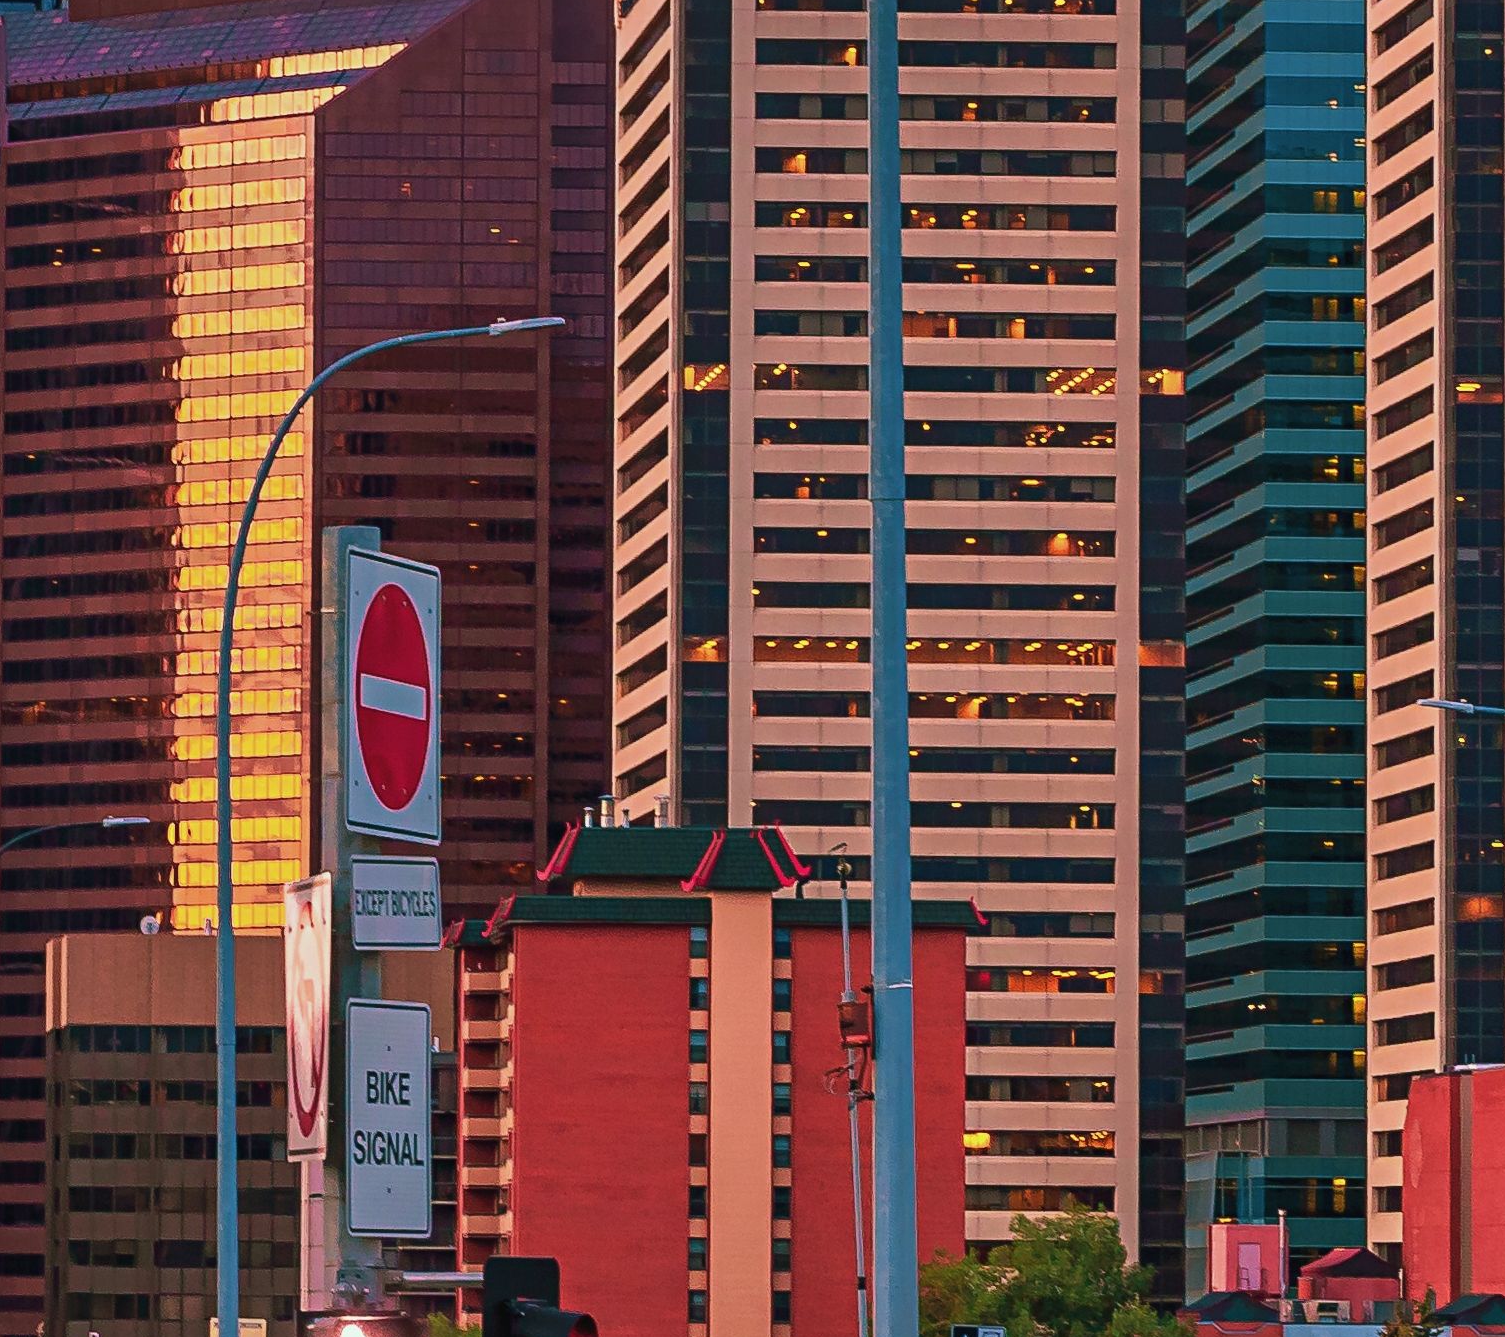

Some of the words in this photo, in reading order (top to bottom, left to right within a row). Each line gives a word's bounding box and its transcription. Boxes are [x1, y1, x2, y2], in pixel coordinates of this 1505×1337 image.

[355, 889, 389, 916] EXCEPT
[391, 889, 436, 918] BICYCLES
[366, 1070, 411, 1106] BIKE
[353, 1130, 425, 1166] SIGNAL
